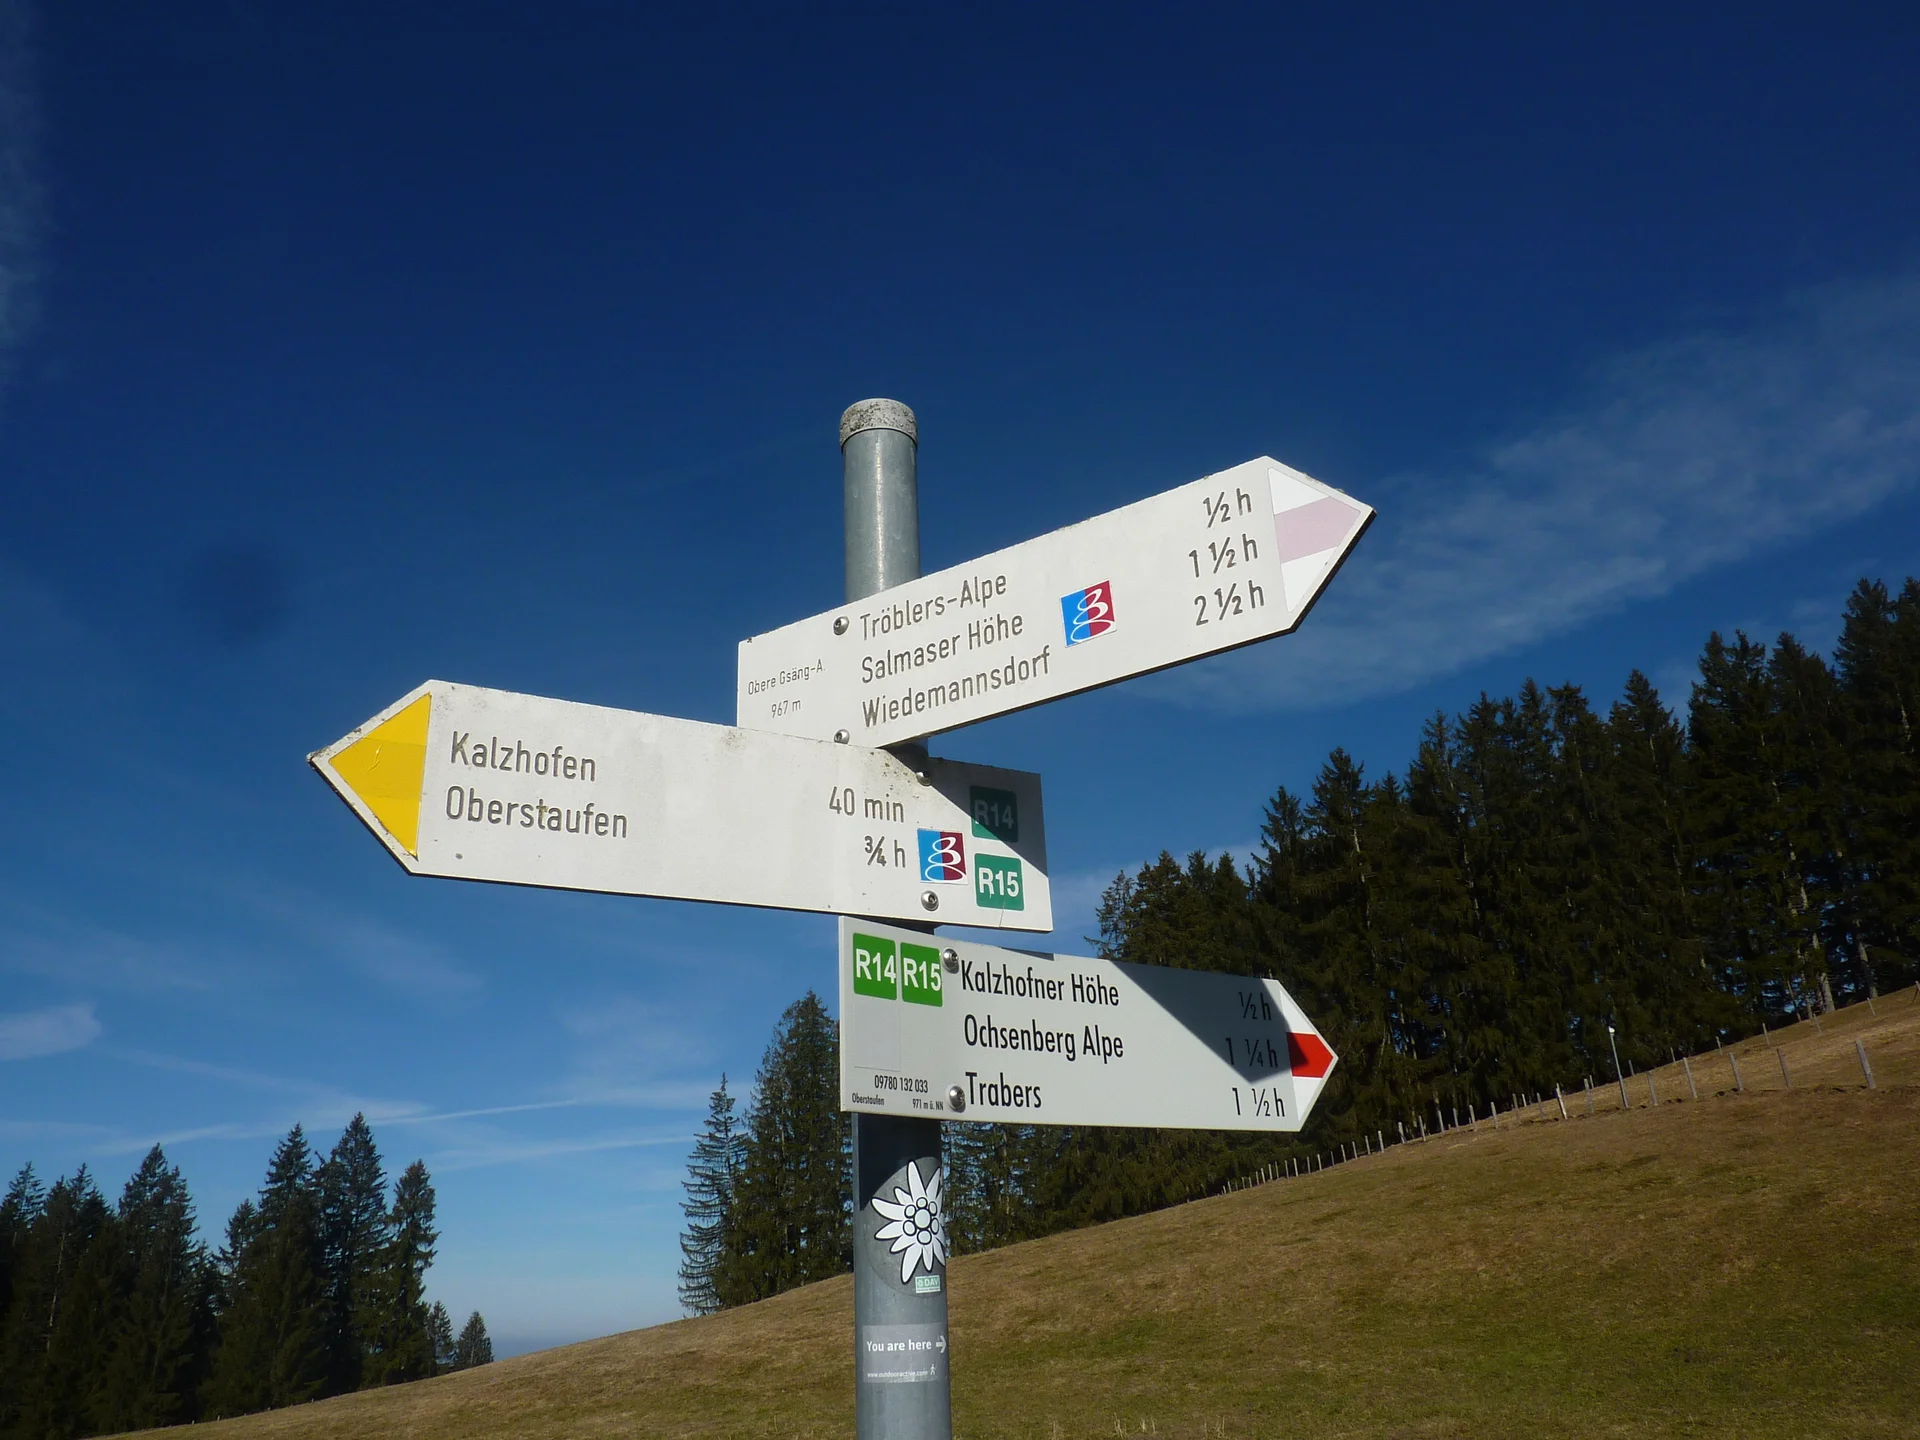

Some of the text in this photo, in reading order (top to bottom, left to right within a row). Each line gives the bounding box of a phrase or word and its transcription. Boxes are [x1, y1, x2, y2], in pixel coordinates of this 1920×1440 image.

[1236, 488, 1252, 516] h
[1188, 549, 1200, 578] 1
[1242, 533, 1258, 562] h
[860, 575, 1007, 641] Tröblers-Alpe
[1194, 595, 1209, 626] 2
[1248, 579, 1265, 609] h
[861, 613, 1023, 684] Salmaser Höhe
[748, 677, 777, 695] Obere
[862, 644, 1050, 728] Wiedemannsdorf
[771, 699, 801, 719] 967 m
[450, 730, 596, 782] Kalzhofen
[445, 785, 628, 839] Oberstaufen
[829, 786, 904, 823] 40 min
[973, 800, 1014, 829] R14
[893, 839, 906, 868] h
[977, 867, 1020, 898] R15
[855, 948, 942, 992] R14 R15
[961, 959, 1120, 1007] Kalzhofner Höhe
[1260, 992, 1271, 1020] h
[964, 1013, 1124, 1065] Ochsenberg Alpe
[1226, 1037, 1234, 1065] 1
[1266, 1039, 1278, 1068] h
[851, 1092, 885, 1106] Oberstaufen
[874, 1074, 929, 1094] 09780 132 033
[965, 1071, 1042, 1109] Trabers
[912, 1098, 922, 1109] 971
[923, 1101, 929, 1109] m
[935, 1101, 944, 1111] NN
[1232, 1087, 1240, 1115] 1
[1273, 1087, 1285, 1117] h
[924, 1277, 940, 1287] DAV
[866, 1338, 932, 1352] You are here
